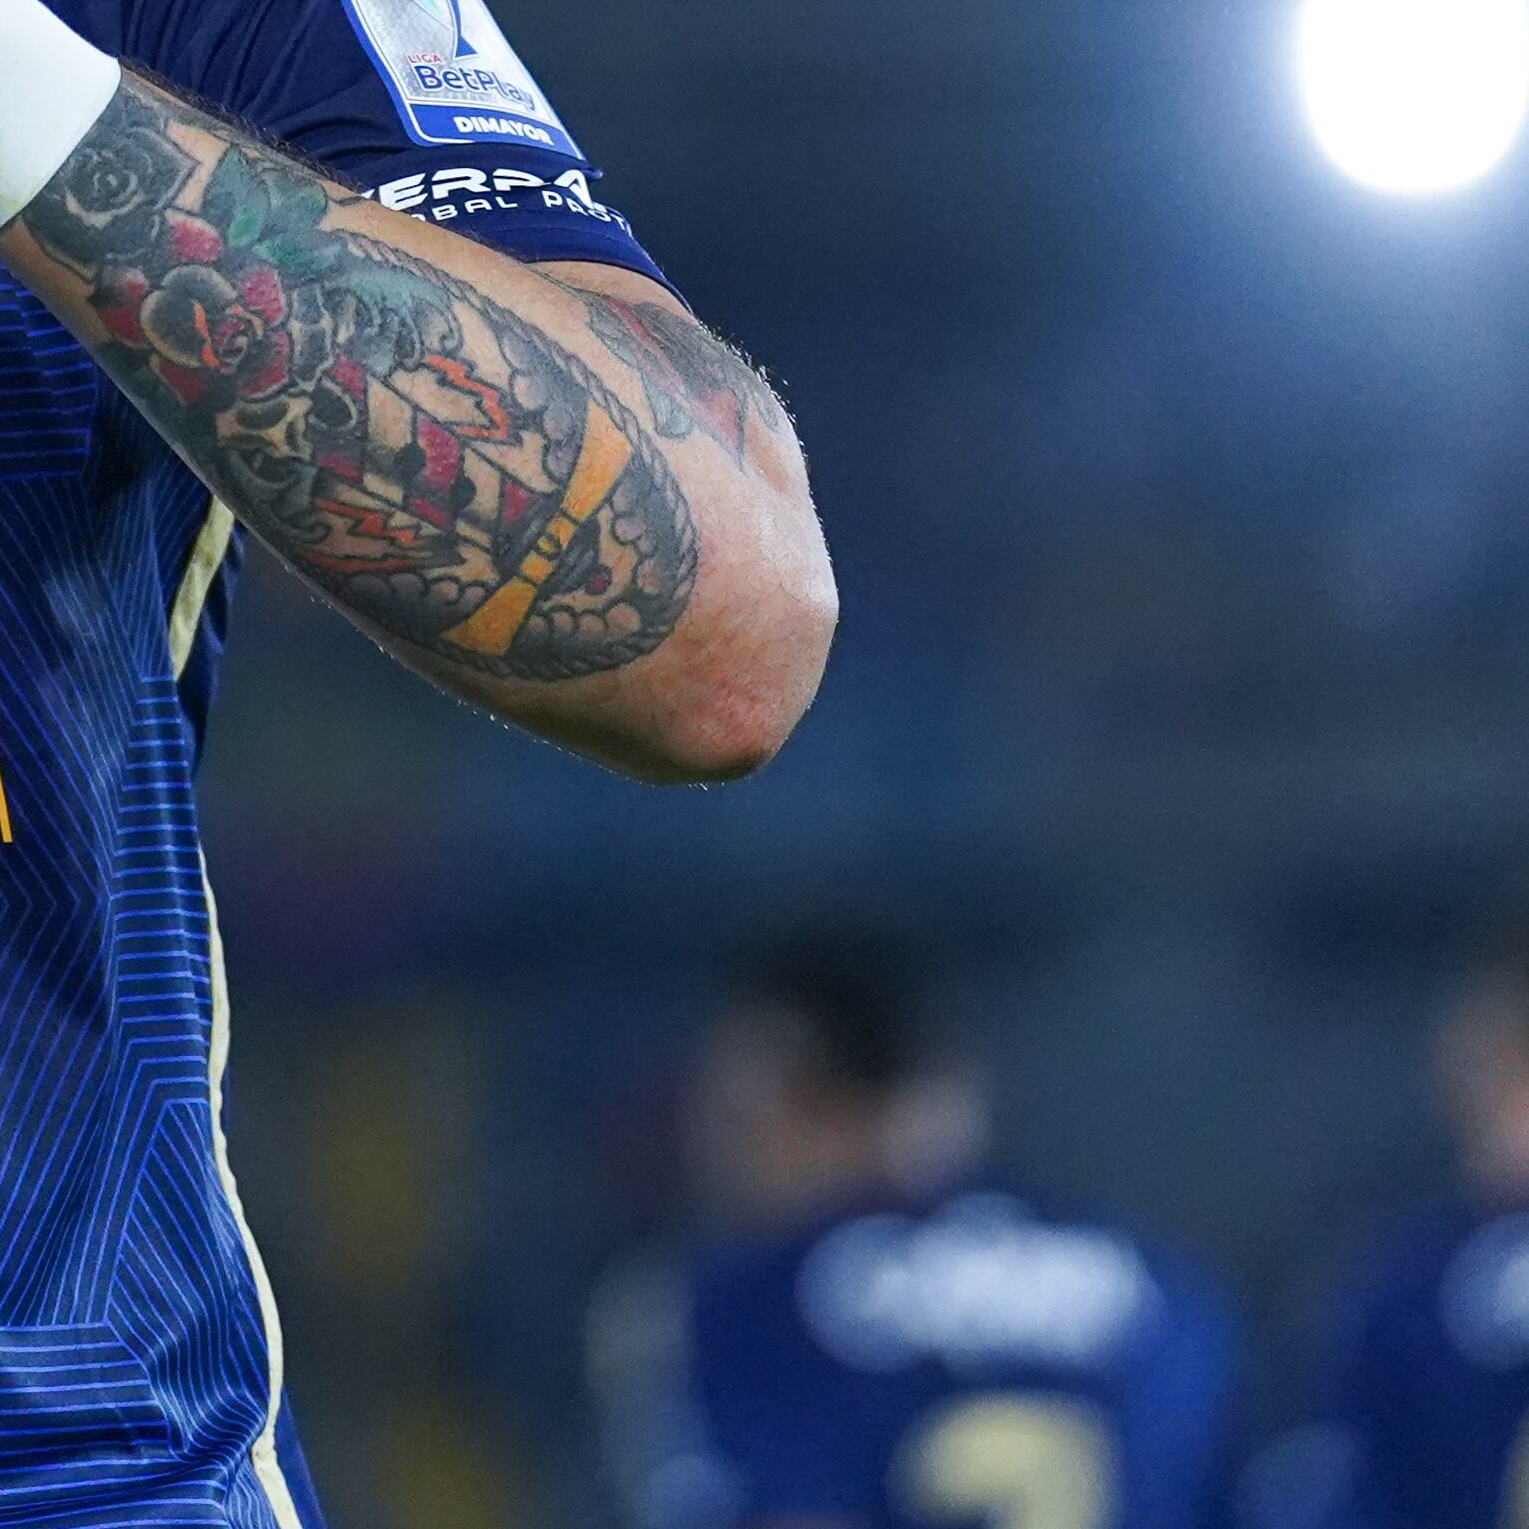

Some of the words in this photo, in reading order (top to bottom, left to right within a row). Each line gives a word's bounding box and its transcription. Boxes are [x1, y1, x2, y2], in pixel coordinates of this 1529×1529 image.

[406, 54, 443, 64] LIGA
[414, 65, 535, 111] BetPlay
[453, 117, 555, 146] DIMAYOR
[410, 196, 519, 222] BAL
